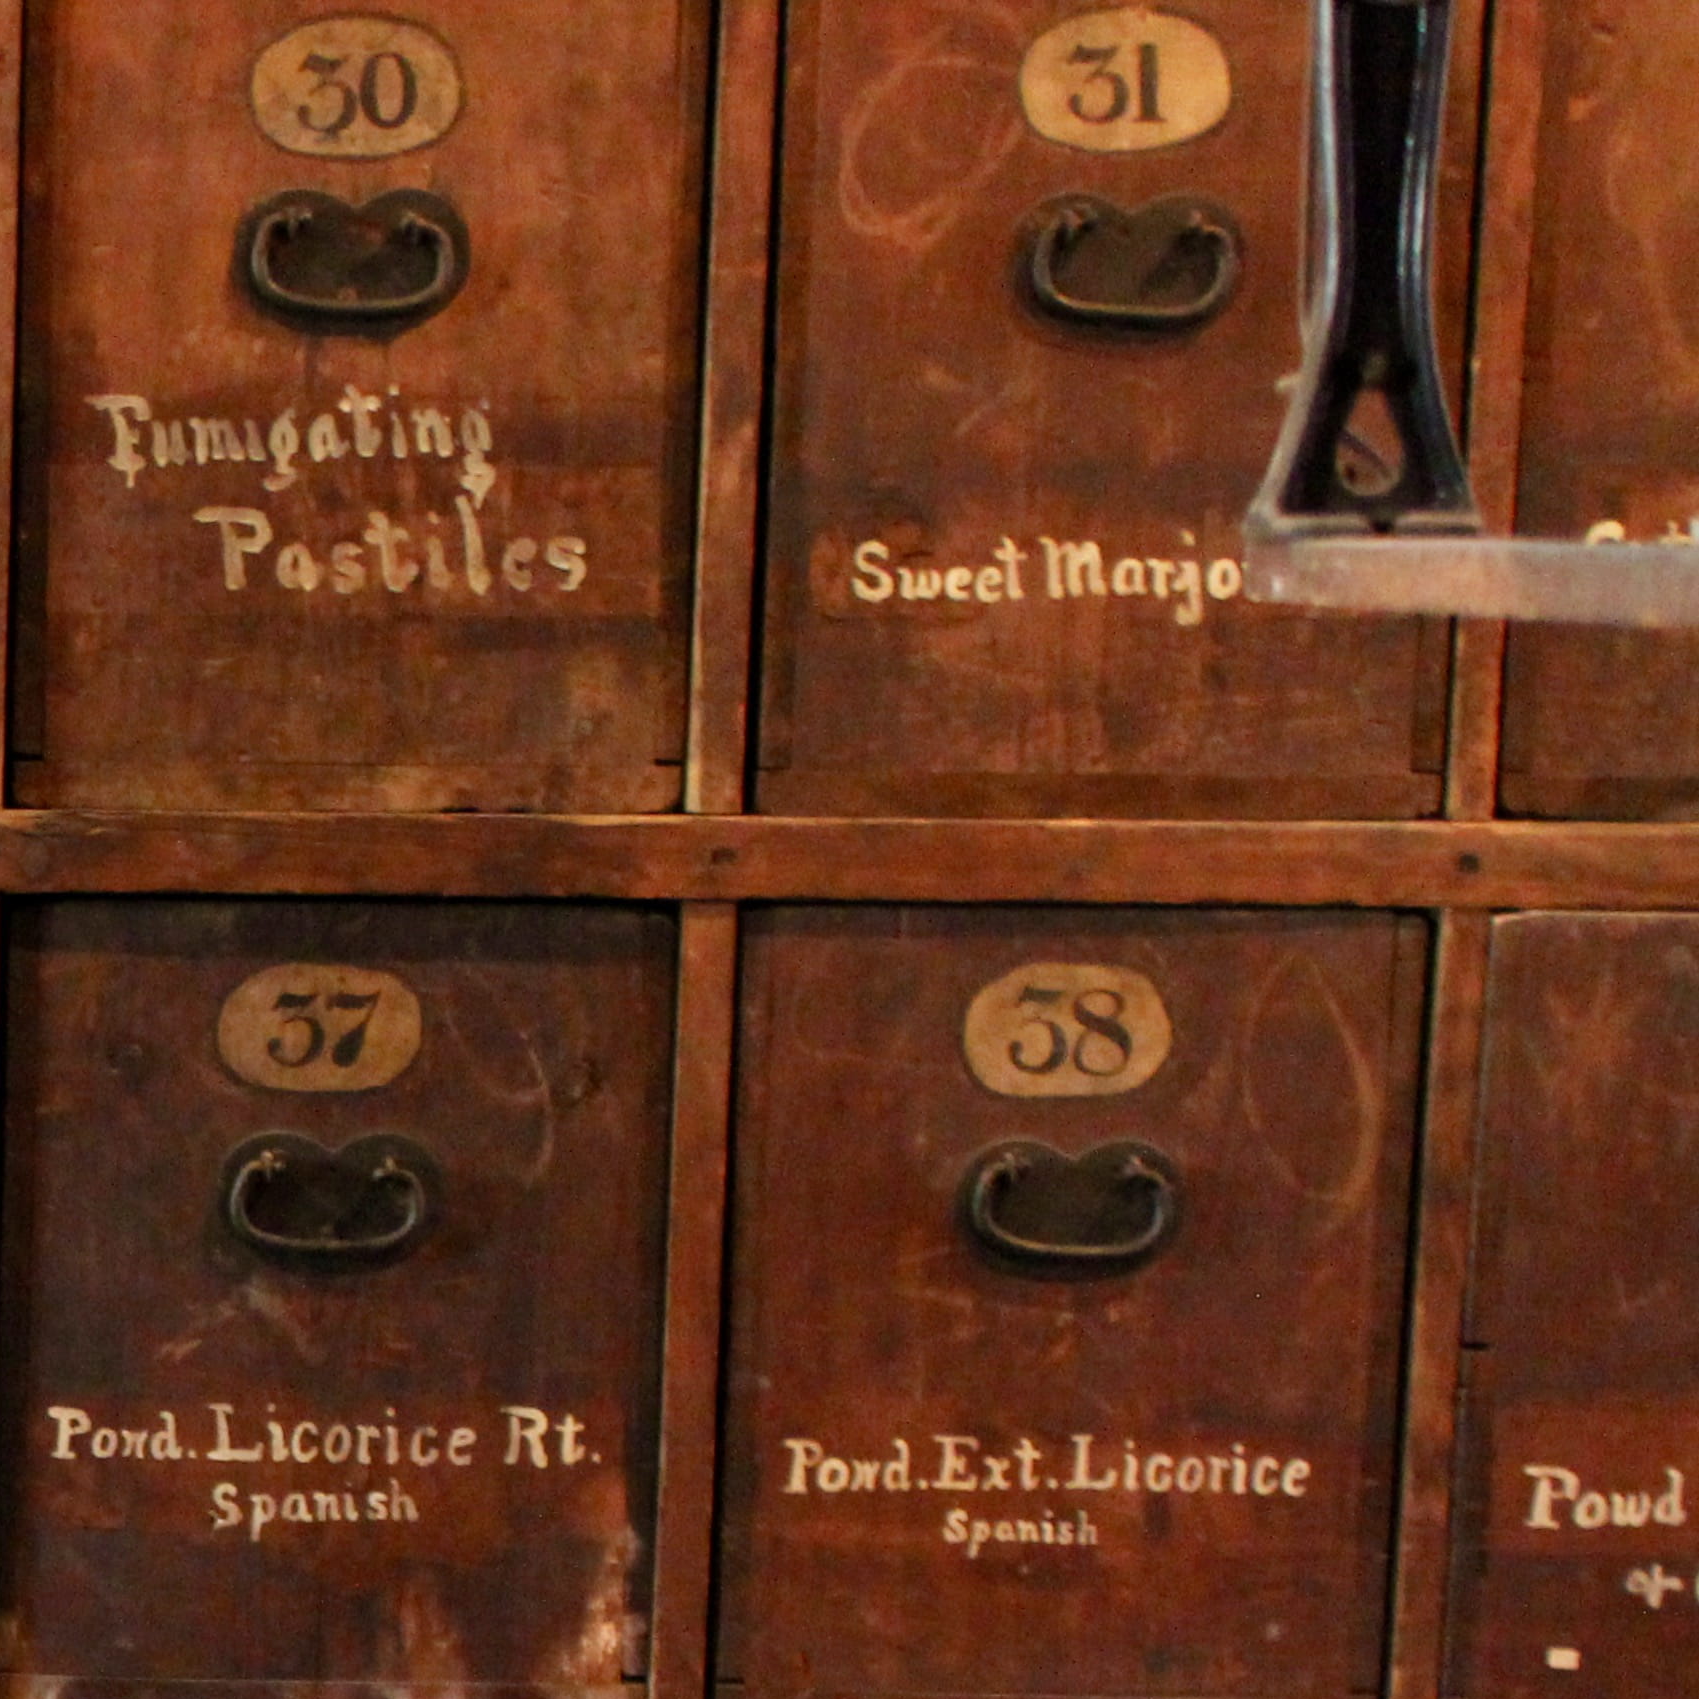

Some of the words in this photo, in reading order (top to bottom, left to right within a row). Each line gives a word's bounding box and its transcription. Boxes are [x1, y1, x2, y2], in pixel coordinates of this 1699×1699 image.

[296, 51, 418, 140] 30
[1066, 43, 1167, 125] 31
[83, 384, 496, 508] Fumigating
[193, 495, 588, 596] Pastiles
[852, 535, 1026, 602] Sweet
[1040, 531, 1250, 626] Marjo
[266, 992, 382, 1070] 37
[1006, 986, 1135, 1077] 38
[206, 1401, 479, 1469] Licorice
[501, 1406, 602, 1469] Rt.
[1063, 1434, 1313, 1497] Licorice
[208, 1478, 420, 1543] Spanish
[942, 1506, 1099, 1558] Spanish
[1523, 1464, 1687, 1530] Powd
